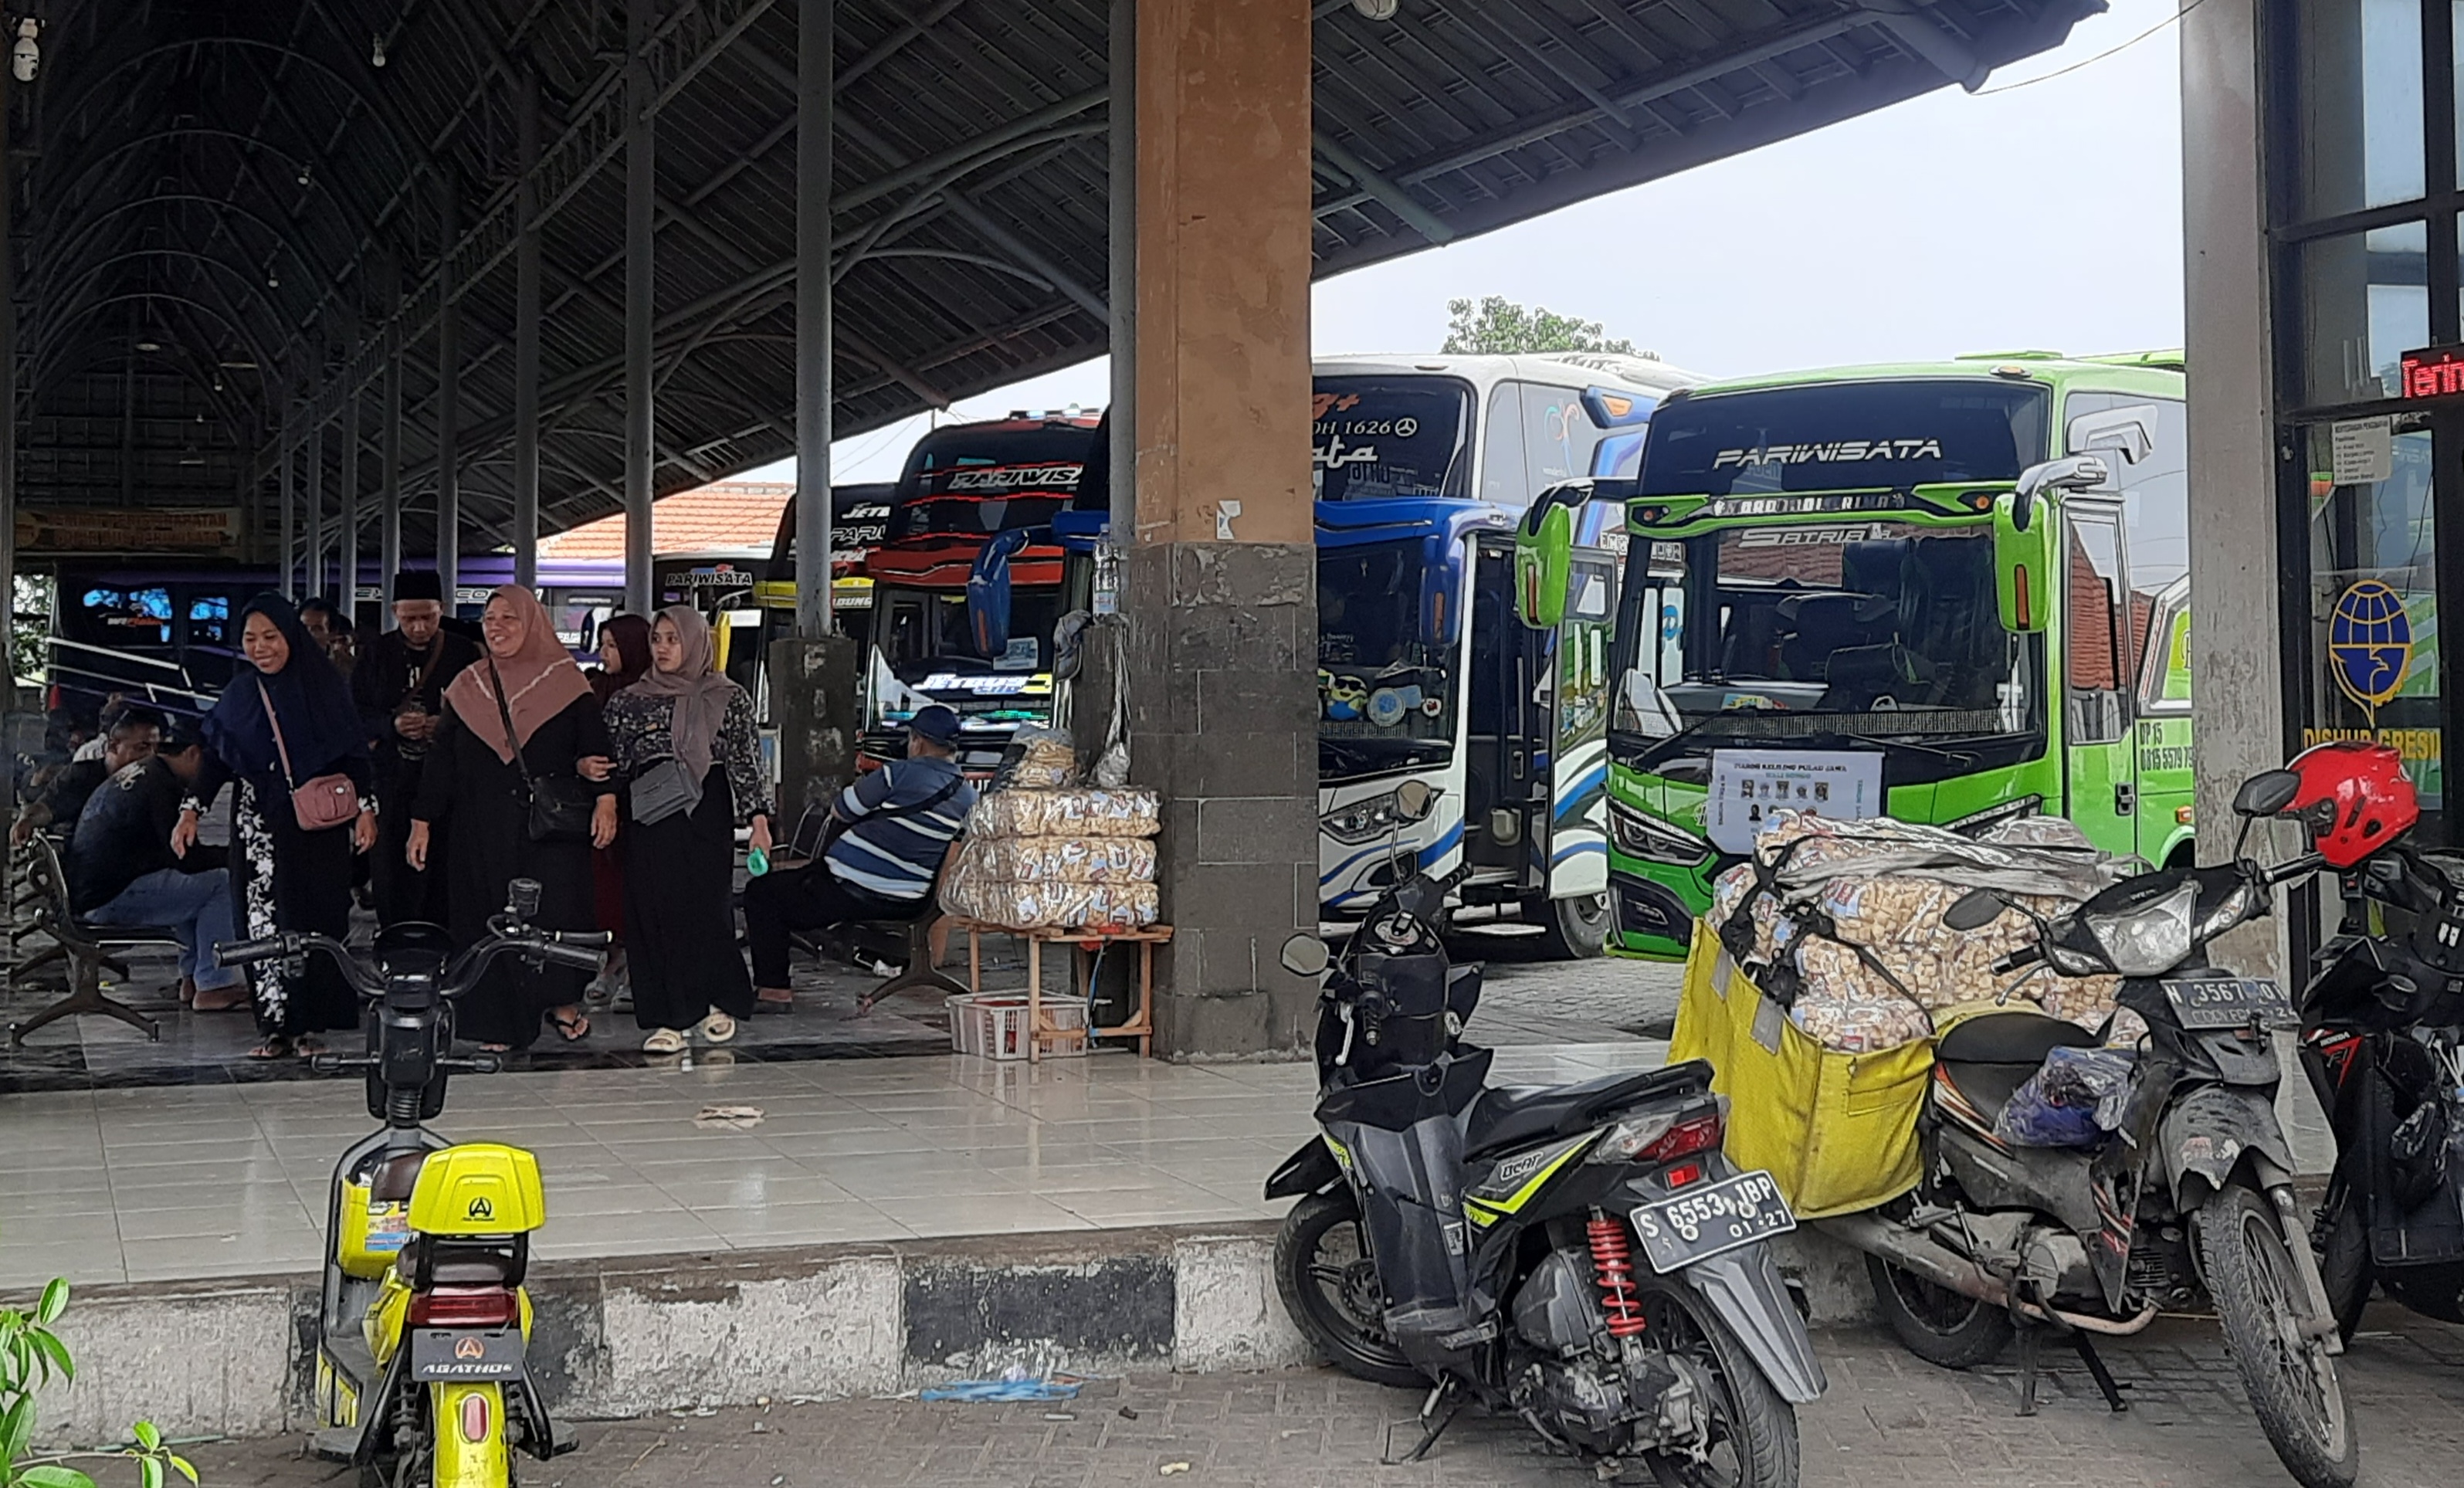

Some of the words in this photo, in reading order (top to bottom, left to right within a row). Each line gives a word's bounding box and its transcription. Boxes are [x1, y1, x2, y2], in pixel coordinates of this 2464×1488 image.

[1344, 421, 1391, 435] 1626
[1713, 439, 1942, 470] PARIWISATA
[665, 572, 753, 586] PARIWISATA
[2193, 983, 2244, 1002] 3567
[1639, 1213, 1659, 1238] S
[1666, 1193, 1726, 1228] 6553
[422, 1363, 513, 1374] AGATHOS
